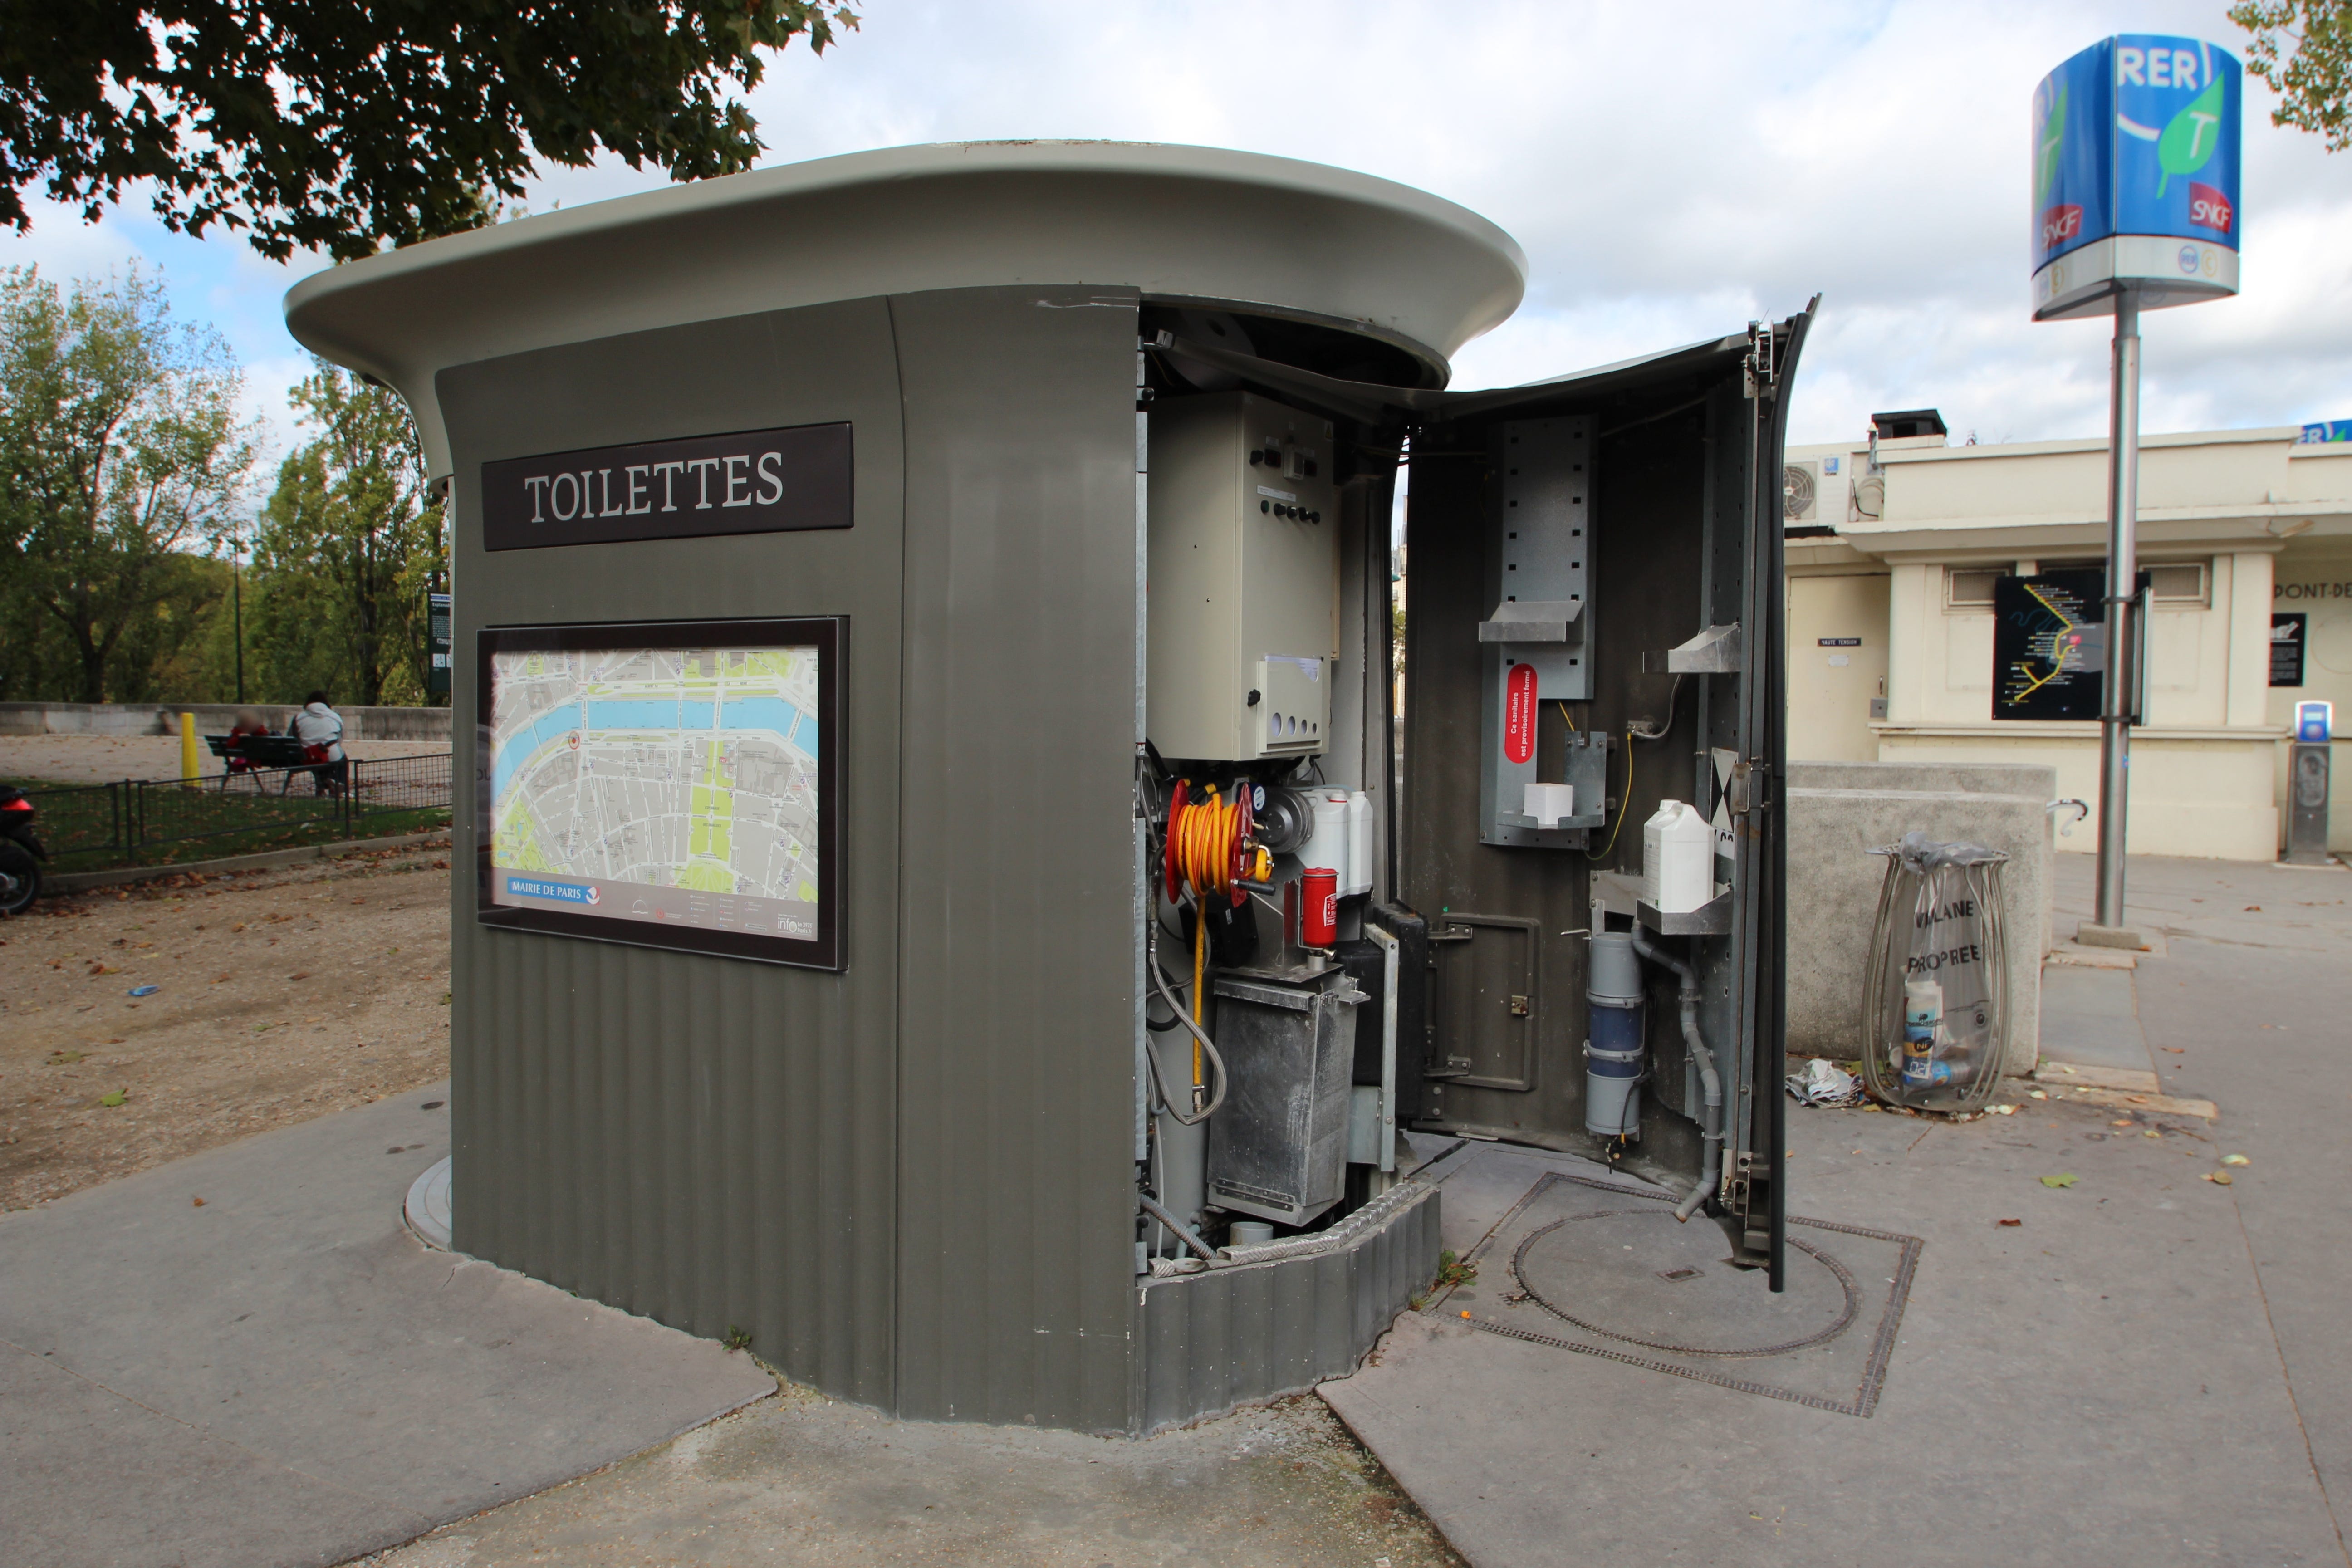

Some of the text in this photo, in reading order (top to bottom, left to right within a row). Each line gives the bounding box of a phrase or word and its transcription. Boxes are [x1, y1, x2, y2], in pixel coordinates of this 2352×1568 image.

[2117, 47, 2198, 91] RER
[2042, 210, 2080, 247] SNCF
[2191, 200, 2231, 227] SNCF
[525, 452, 783, 523] TOILETTES
[1511, 724, 1517, 734] Ce
[1521, 692, 1529, 745] provisoirement
[512, 881, 581, 899] MAIRIE DE PARIS
